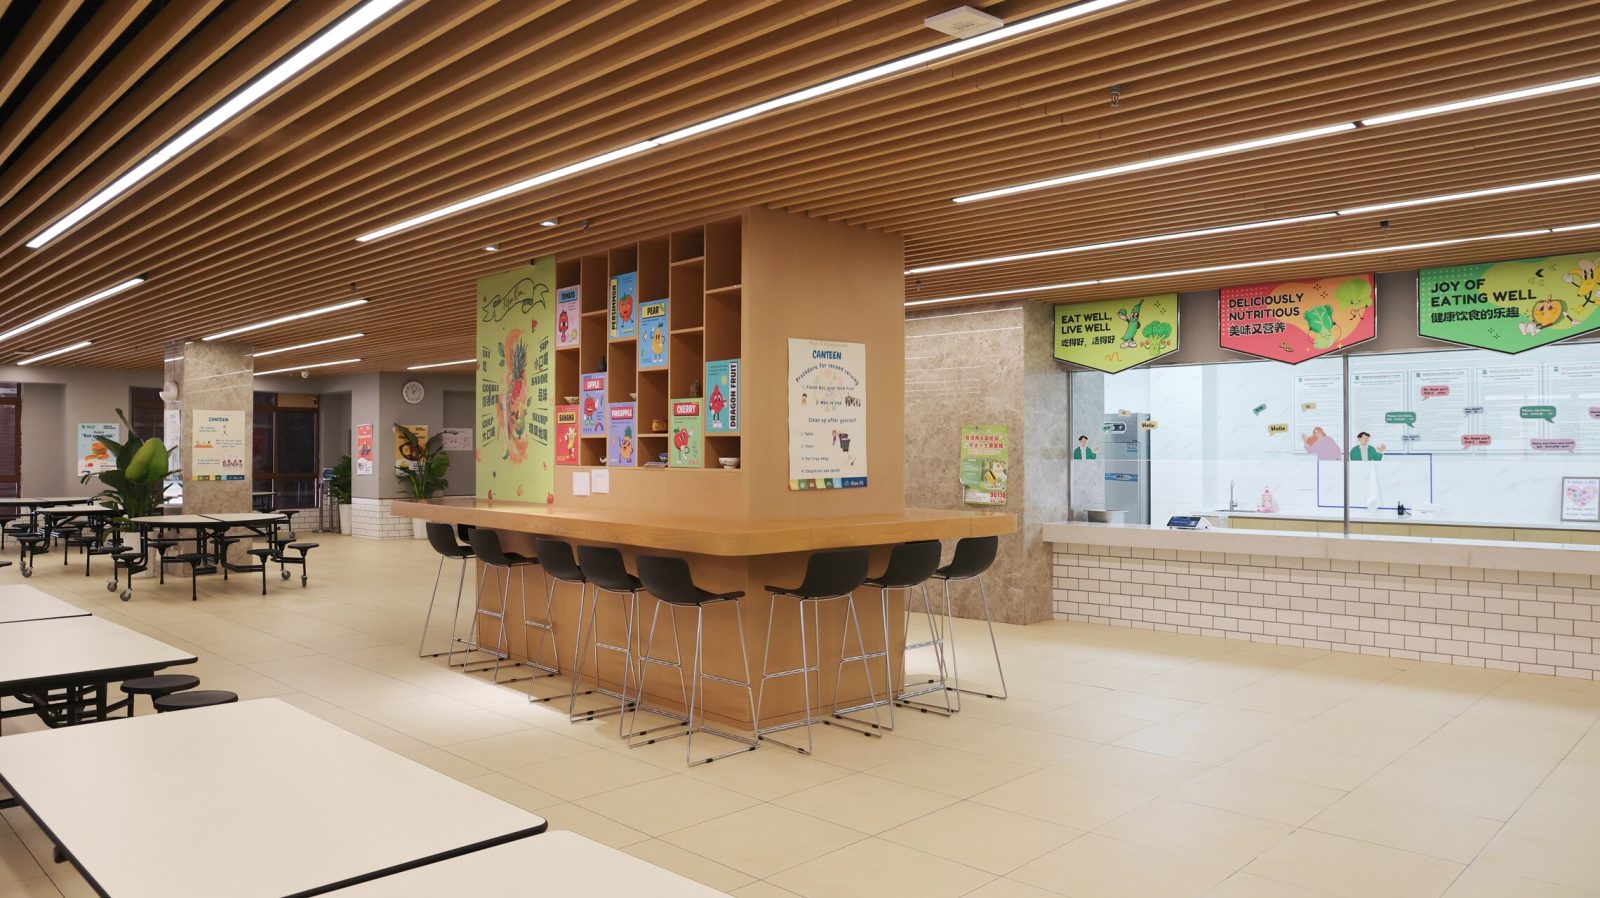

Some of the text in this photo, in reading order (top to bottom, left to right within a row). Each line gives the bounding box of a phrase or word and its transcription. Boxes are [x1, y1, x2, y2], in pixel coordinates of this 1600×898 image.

[1431, 279, 1486, 293] JOY OF
[561, 291, 576, 300] TOMATO
[1229, 293, 1304, 308] DELICIOUSLY
[1431, 289, 1537, 307] EATING WELL
[647, 306, 660, 315] PEAR
[1229, 307, 1300, 321] NUTRITIOUS
[1430, 306, 1520, 323] 健康饮食的乐趣
[1061, 312, 1113, 324] EAT WELL,
[1061, 323, 1111, 335] LIVE WELL
[1229, 322, 1286, 337] 美味又营养
[812, 349, 842, 360] CANTEEN
[531, 373, 548, 386] SAVOR
[795, 365, 818, 383] Procedure
[587, 380, 600, 389] APPLE
[611, 409, 633, 417] PINEAPPLE
[676, 405, 696, 413] CHERRY
[559, 413, 575, 422] BANANA
